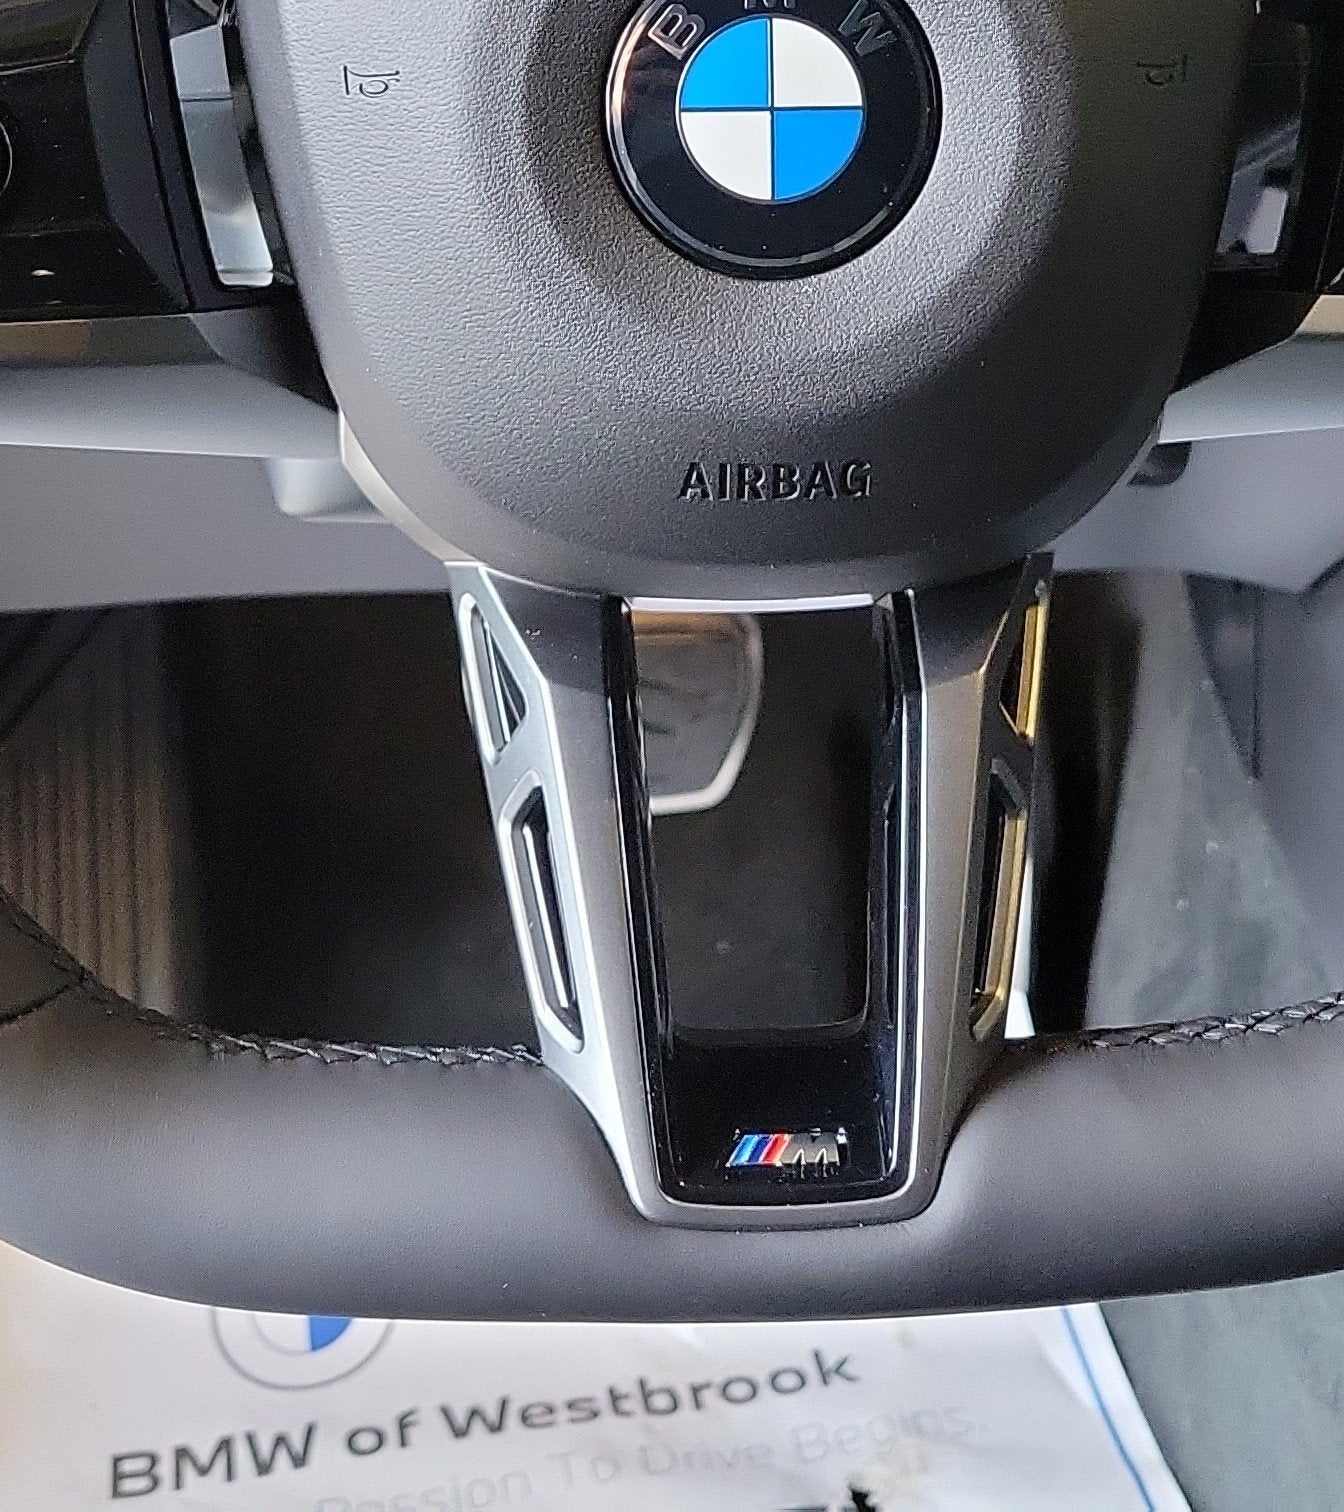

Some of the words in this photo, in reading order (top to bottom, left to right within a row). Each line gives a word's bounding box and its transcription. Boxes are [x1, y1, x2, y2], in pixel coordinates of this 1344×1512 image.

[678, 460, 873, 501] AIRBAG
[109, 1421, 318, 1500] BMW
[346, 1407, 420, 1458] of
[439, 1349, 861, 1441] Westbrook
[549, 1448, 623, 1487] To
[640, 1441, 775, 1477] Drive
